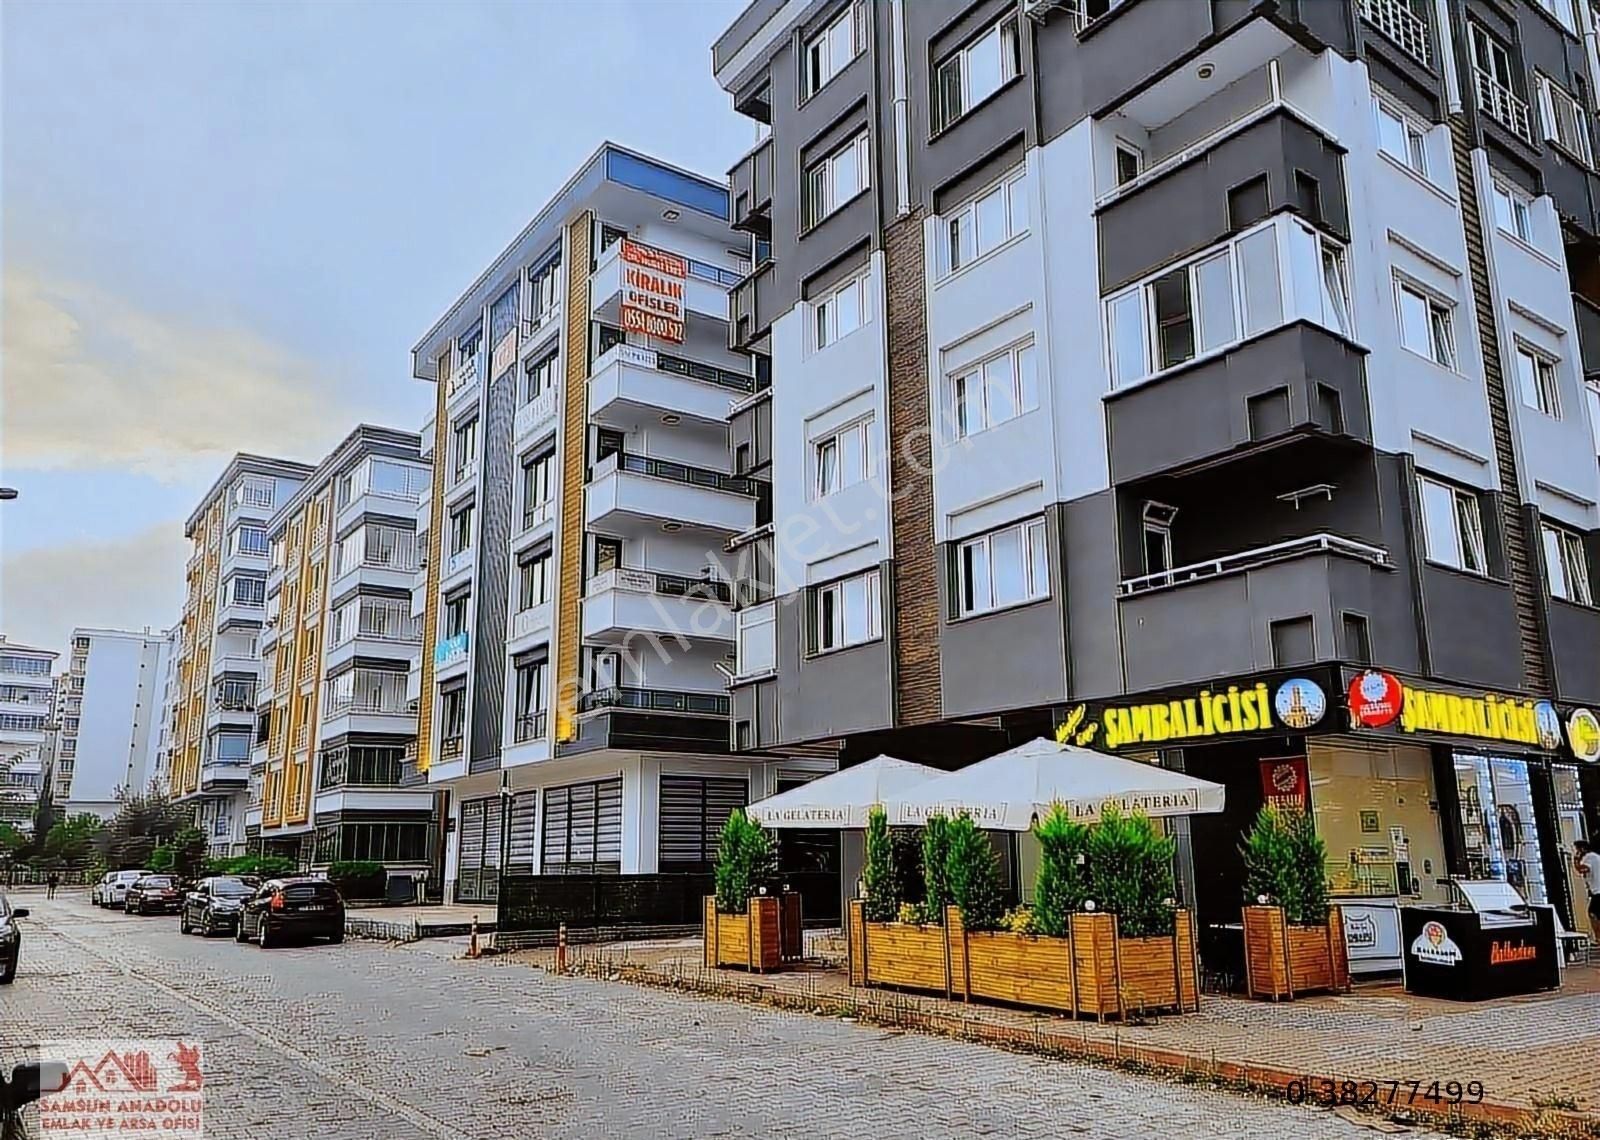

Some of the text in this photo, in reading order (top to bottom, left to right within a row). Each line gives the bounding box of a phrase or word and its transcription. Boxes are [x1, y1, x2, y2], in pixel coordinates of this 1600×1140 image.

[625, 266, 683, 301] KİRALIK
[767, 809, 845, 822] LA GELATERIA
[1075, 804, 1094, 818] LA
